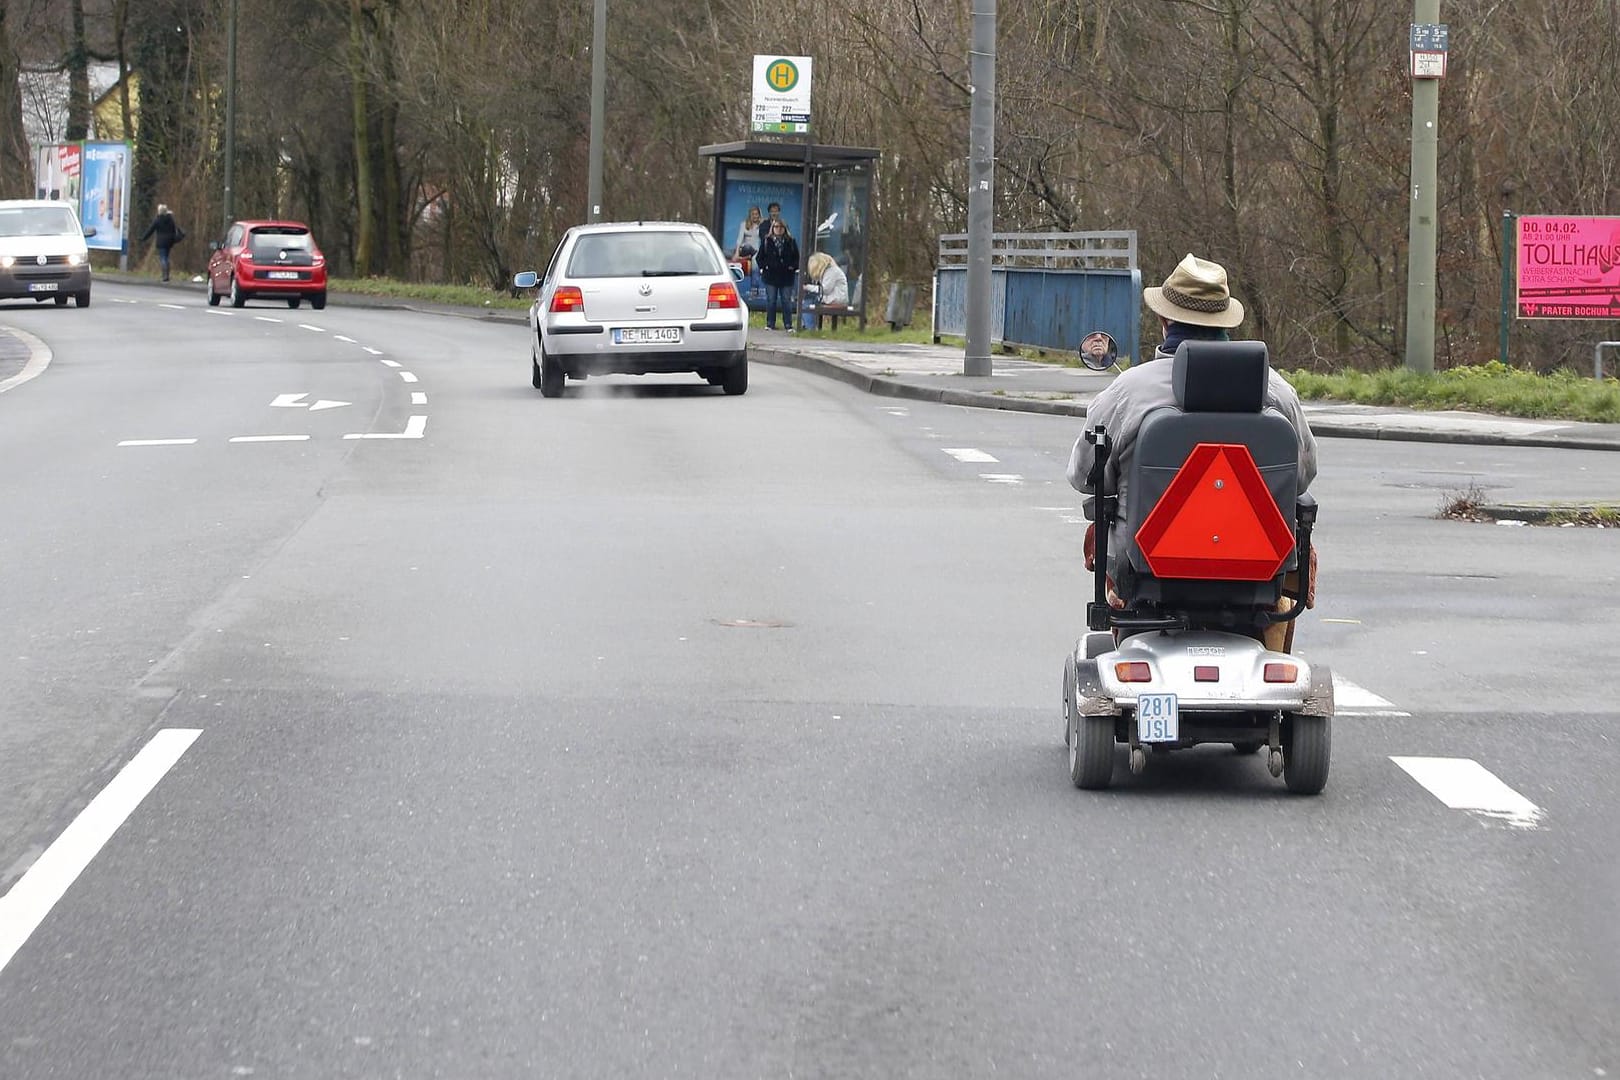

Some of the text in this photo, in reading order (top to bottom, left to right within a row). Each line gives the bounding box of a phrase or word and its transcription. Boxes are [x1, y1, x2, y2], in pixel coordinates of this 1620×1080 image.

[776, 66, 789, 85] H
[1523, 223, 1580, 234] DO. 04.02.
[1523, 275, 1545, 283] EXTRA
[1542, 306, 1573, 315] PRATER
[1575, 306, 1609, 316] BOCHUM
[622, 329, 678, 340] RE HL 1403
[1142, 697, 1172, 717] 281
[1144, 719, 1174, 738] JSL
